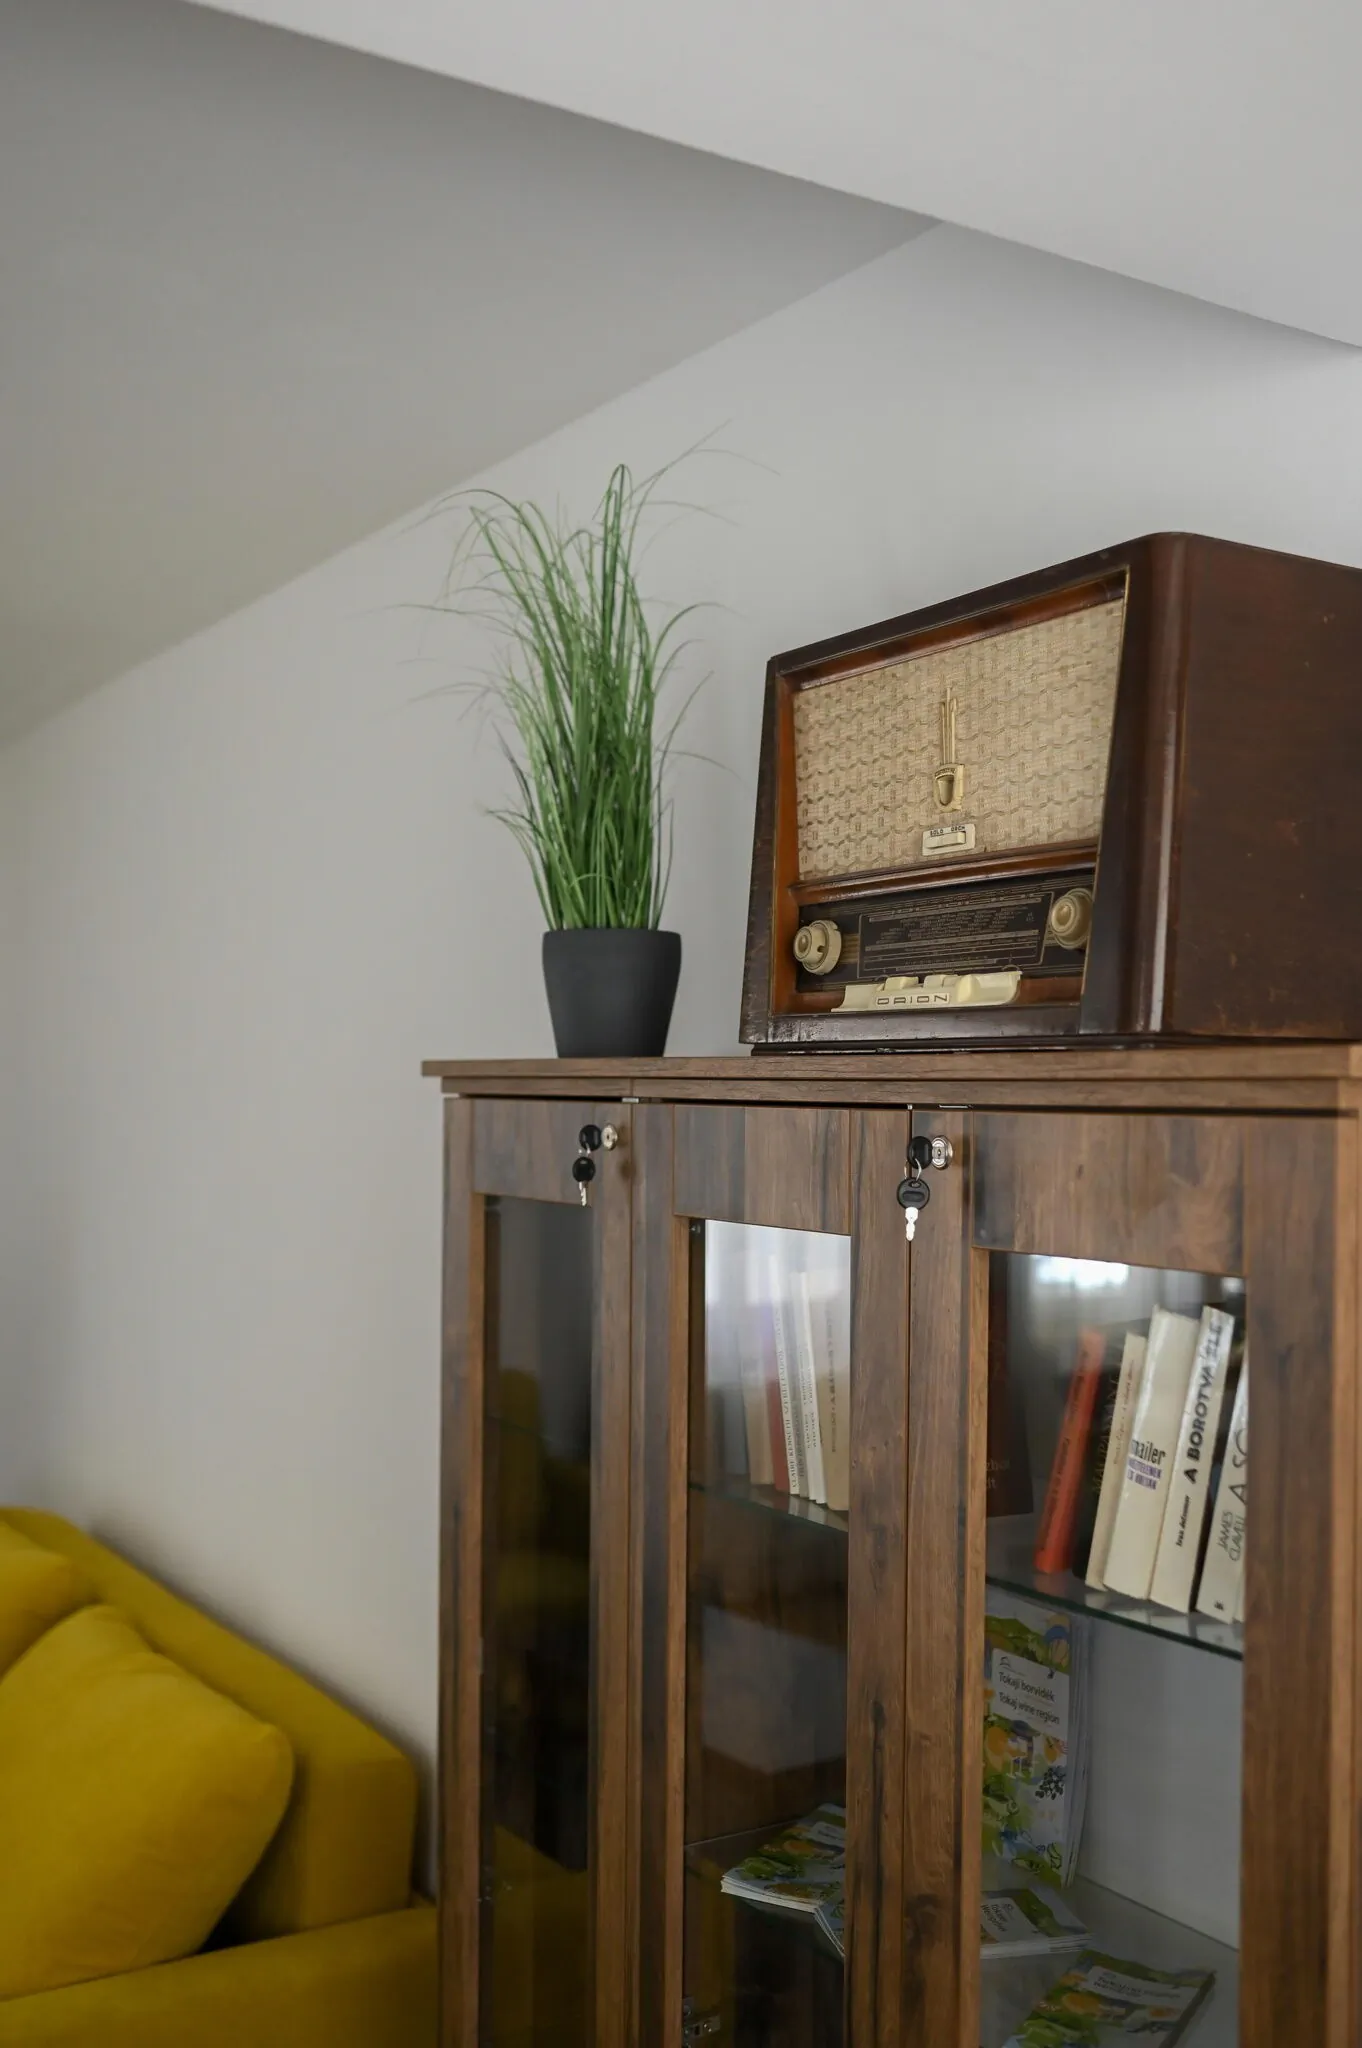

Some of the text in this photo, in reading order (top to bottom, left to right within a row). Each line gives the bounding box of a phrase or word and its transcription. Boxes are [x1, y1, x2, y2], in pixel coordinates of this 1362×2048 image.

[877, 994, 948, 1005] ORION
[1187, 1366, 1215, 1462] BOROTVA
[1184, 1468, 1198, 1484] A
[1229, 1483, 1247, 1506] A
[1217, 1511, 1233, 1550] JAMES
